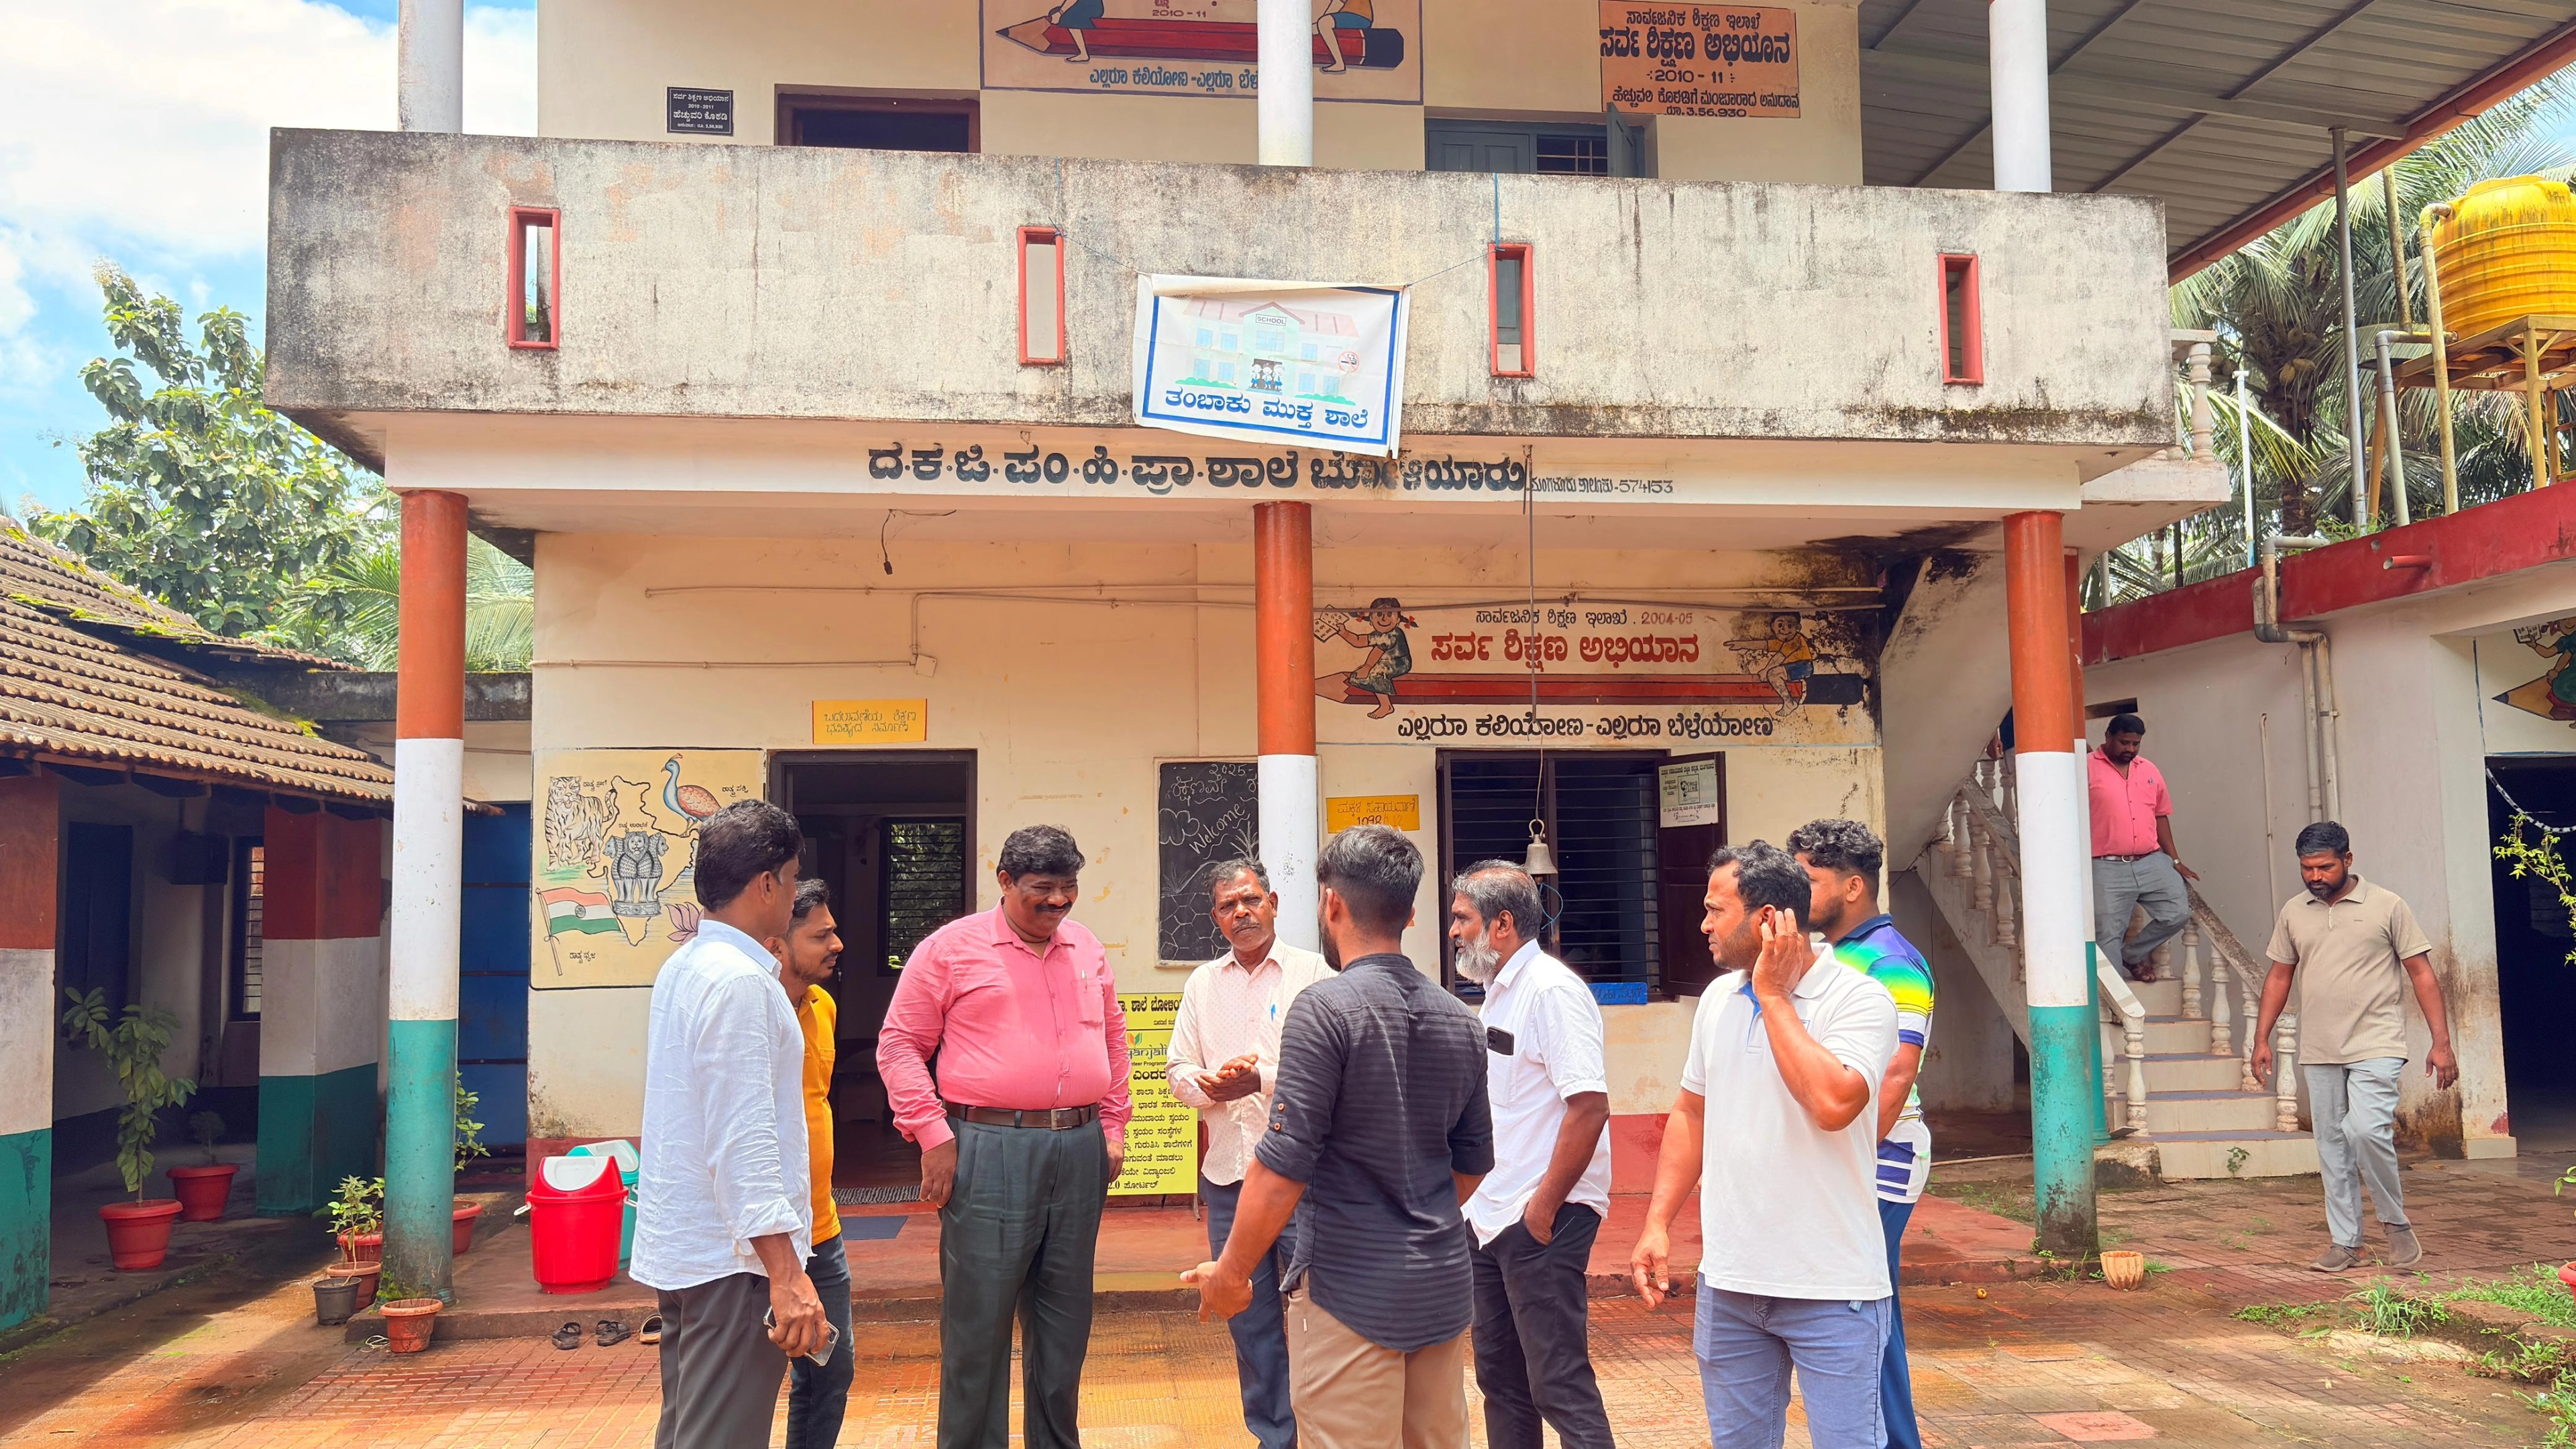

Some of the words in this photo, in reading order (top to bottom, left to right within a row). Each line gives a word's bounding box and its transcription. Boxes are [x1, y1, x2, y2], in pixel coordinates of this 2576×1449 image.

[1627, 9, 1686, 26] ಸಾರ್ವಜನಿಕ
[1693, 7, 1720, 32] ಶಿಕ್ಷಣ
[1726, 12, 1761, 30] ಇಲಾಖೆ
[1599, 25, 1640, 58] ಸರ್ವ
[1646, 25, 1695, 67] ಶಿಕ್ಷಣ
[1704, 32, 1790, 67] ಅಭಿಯಾನ
[688, 94, 702, 102] ಶಿಕ್ಷಣ
[1613, 85, 1653, 108] ಹೆಚ್ಚುವರಿ
[1760, 93, 1799, 109] ಅನುದಾನ
[673, 110, 702, 122] ಹೆಚ್ಚುವರಿ
[704, 111, 728, 121] ಕೊಠಡಿ
[1257, 316, 1286, 325] SCHOOL
[1165, 386, 1250, 415] ತಂಬಾಕು
[1263, 396, 1313, 429] ಮುಕ್ತ
[1325, 409, 1368, 429] ಶಾಲೆ
[1477, 608, 1540, 624] ಸಾರ್ವಜನಿಕ
[1548, 608, 1576, 629] ಶಿಕ್ಷಣ
[1431, 631, 1493, 661] ಸರ್ವ
[1504, 629, 1568, 672] ಶಿಕ್ಷಣ
[1579, 633, 1699, 668] ಅಭಿಯಾನ
[1398, 714, 1468, 741] ಎಲ್ಲರೂ
[1667, 712, 1773, 739] ಬೆಳೆಯೋಣ
[1337, 800, 1361, 817] ಮಕ್ಕಳ
[1189, 803, 1245, 855] Welcome
[1131, 996, 1148, 1012] ಶಾಲೆ
[1128, 1043, 1167, 1059] yanjali
[1138, 1101, 1157, 1110] ಭಾರತ
[1156, 1154, 1183, 1162] ಮಾಡಲು
[1124, 1181, 1159, 1189] ಪೋರ್ಟಲ್
